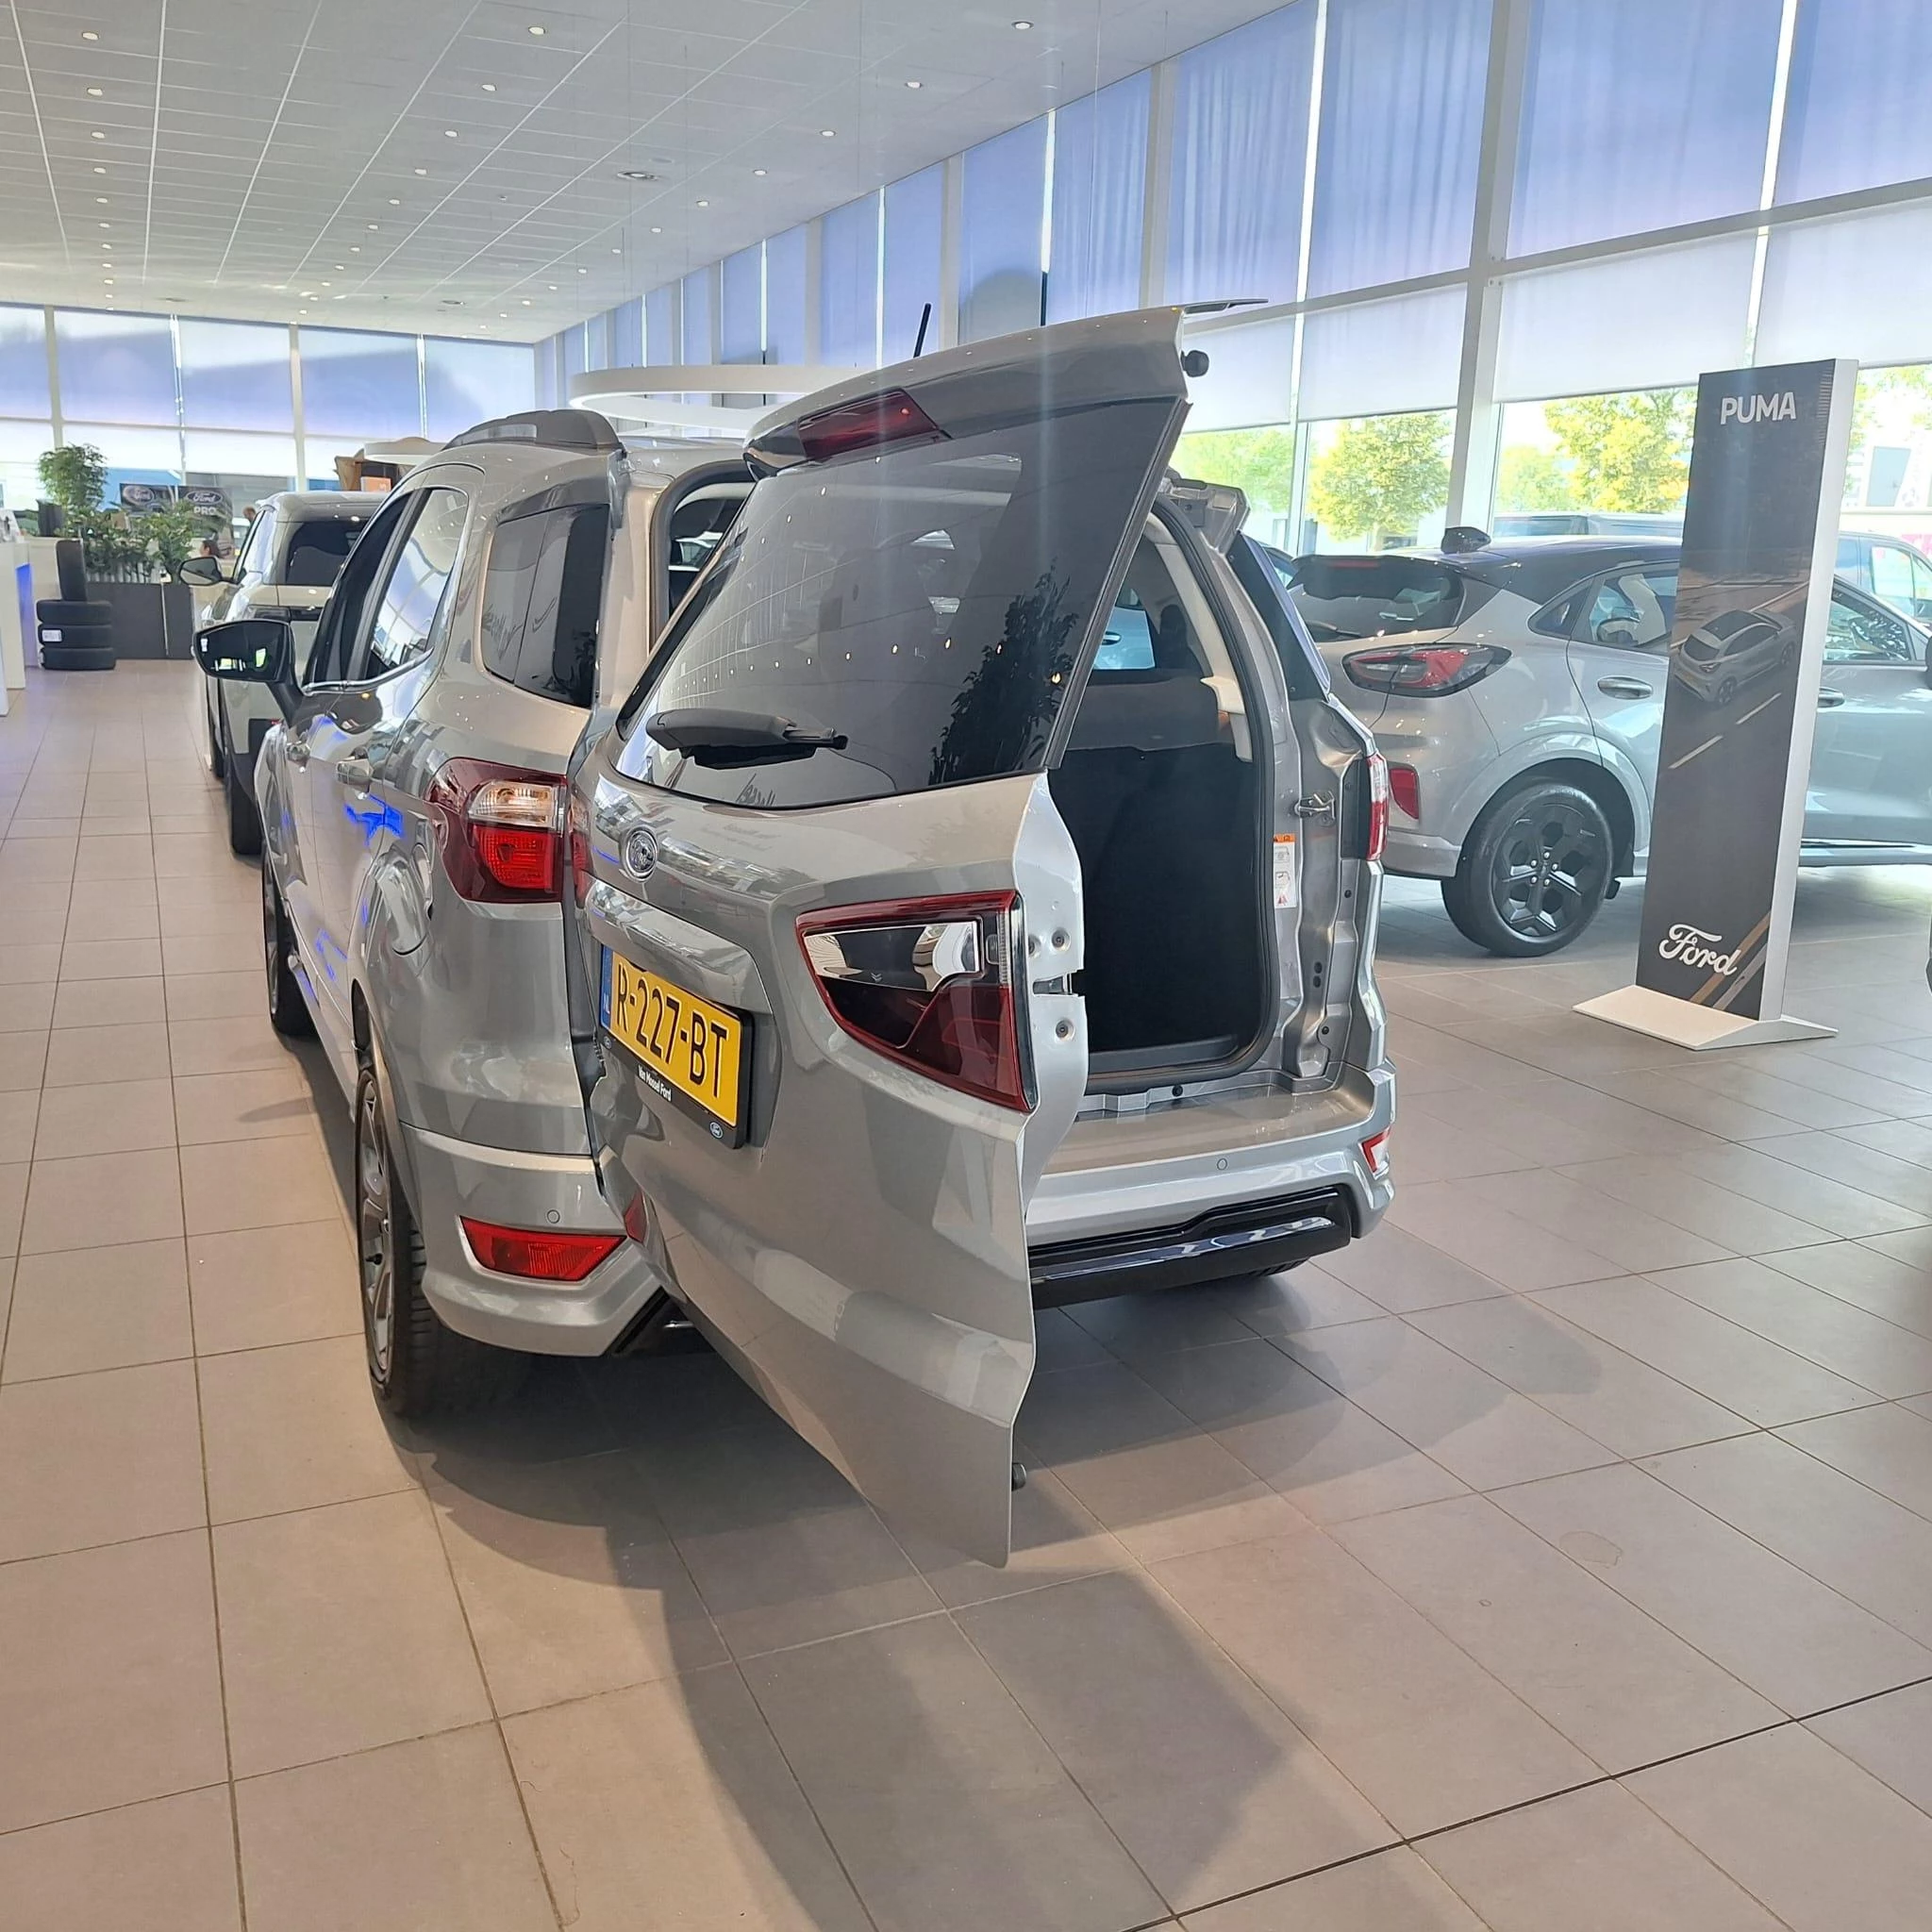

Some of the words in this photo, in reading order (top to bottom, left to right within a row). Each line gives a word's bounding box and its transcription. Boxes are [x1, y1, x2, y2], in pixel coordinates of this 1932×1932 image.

[1720, 391, 1796, 425] PUMA
[192, 492, 216, 503] Ford
[193, 506, 216, 515] PRO
[1658, 924, 1741, 975] Ford
[617, 962, 728, 1098] R-227-BT
[638, 1064, 646, 1081] Van
[659, 1083, 672, 1102] Ford
